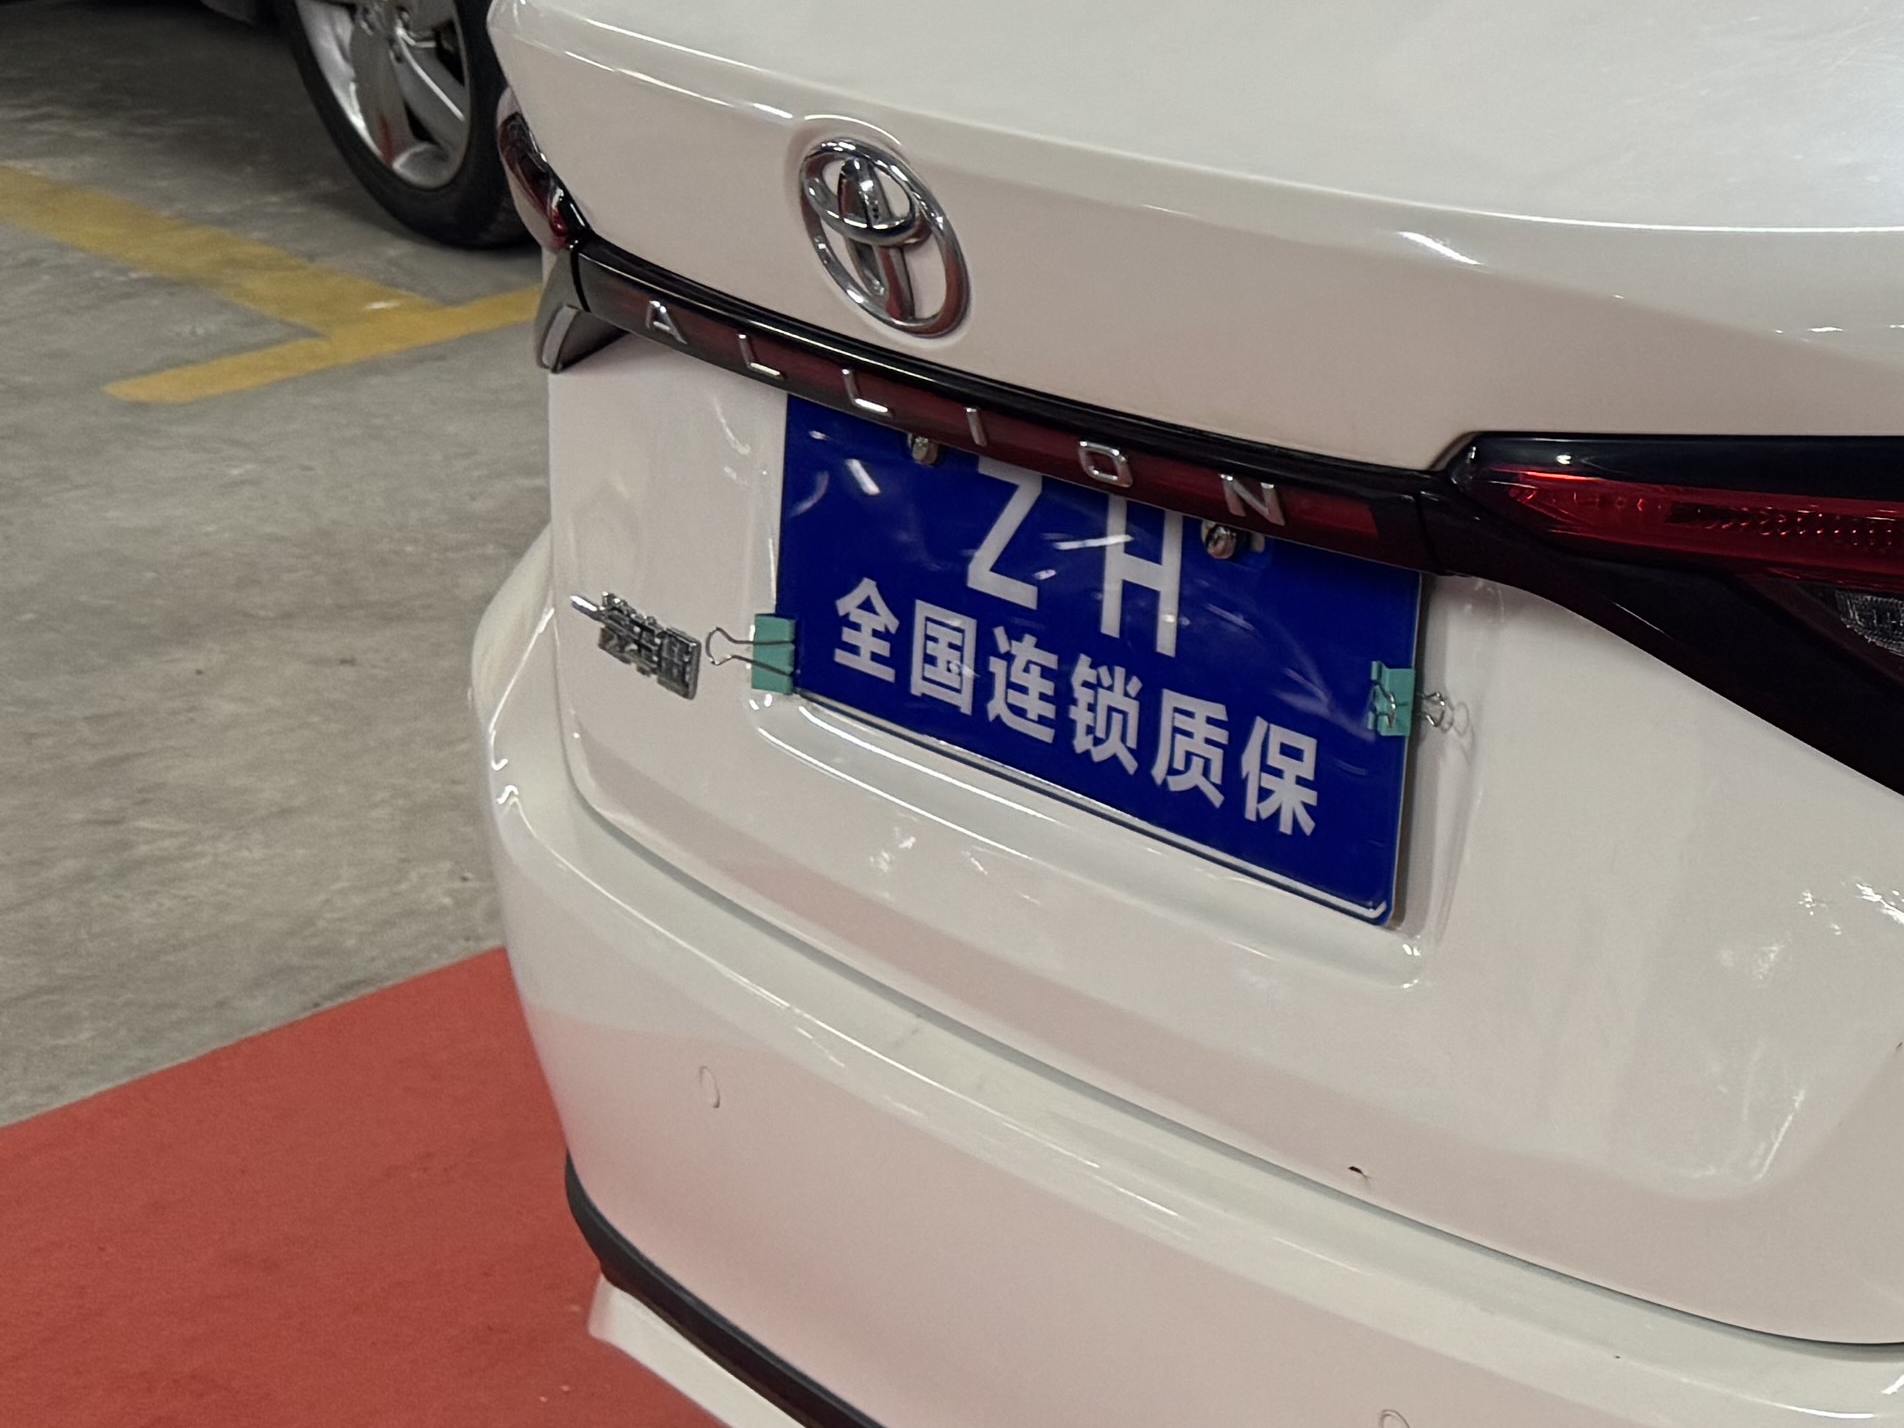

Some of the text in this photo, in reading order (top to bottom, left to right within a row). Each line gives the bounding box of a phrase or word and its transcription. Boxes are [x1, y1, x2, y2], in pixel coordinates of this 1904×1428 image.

[643, 298, 1287, 527] ALLION
[966, 460, 1184, 657] ZH
[833, 576, 1320, 837] 全国连锁质保
